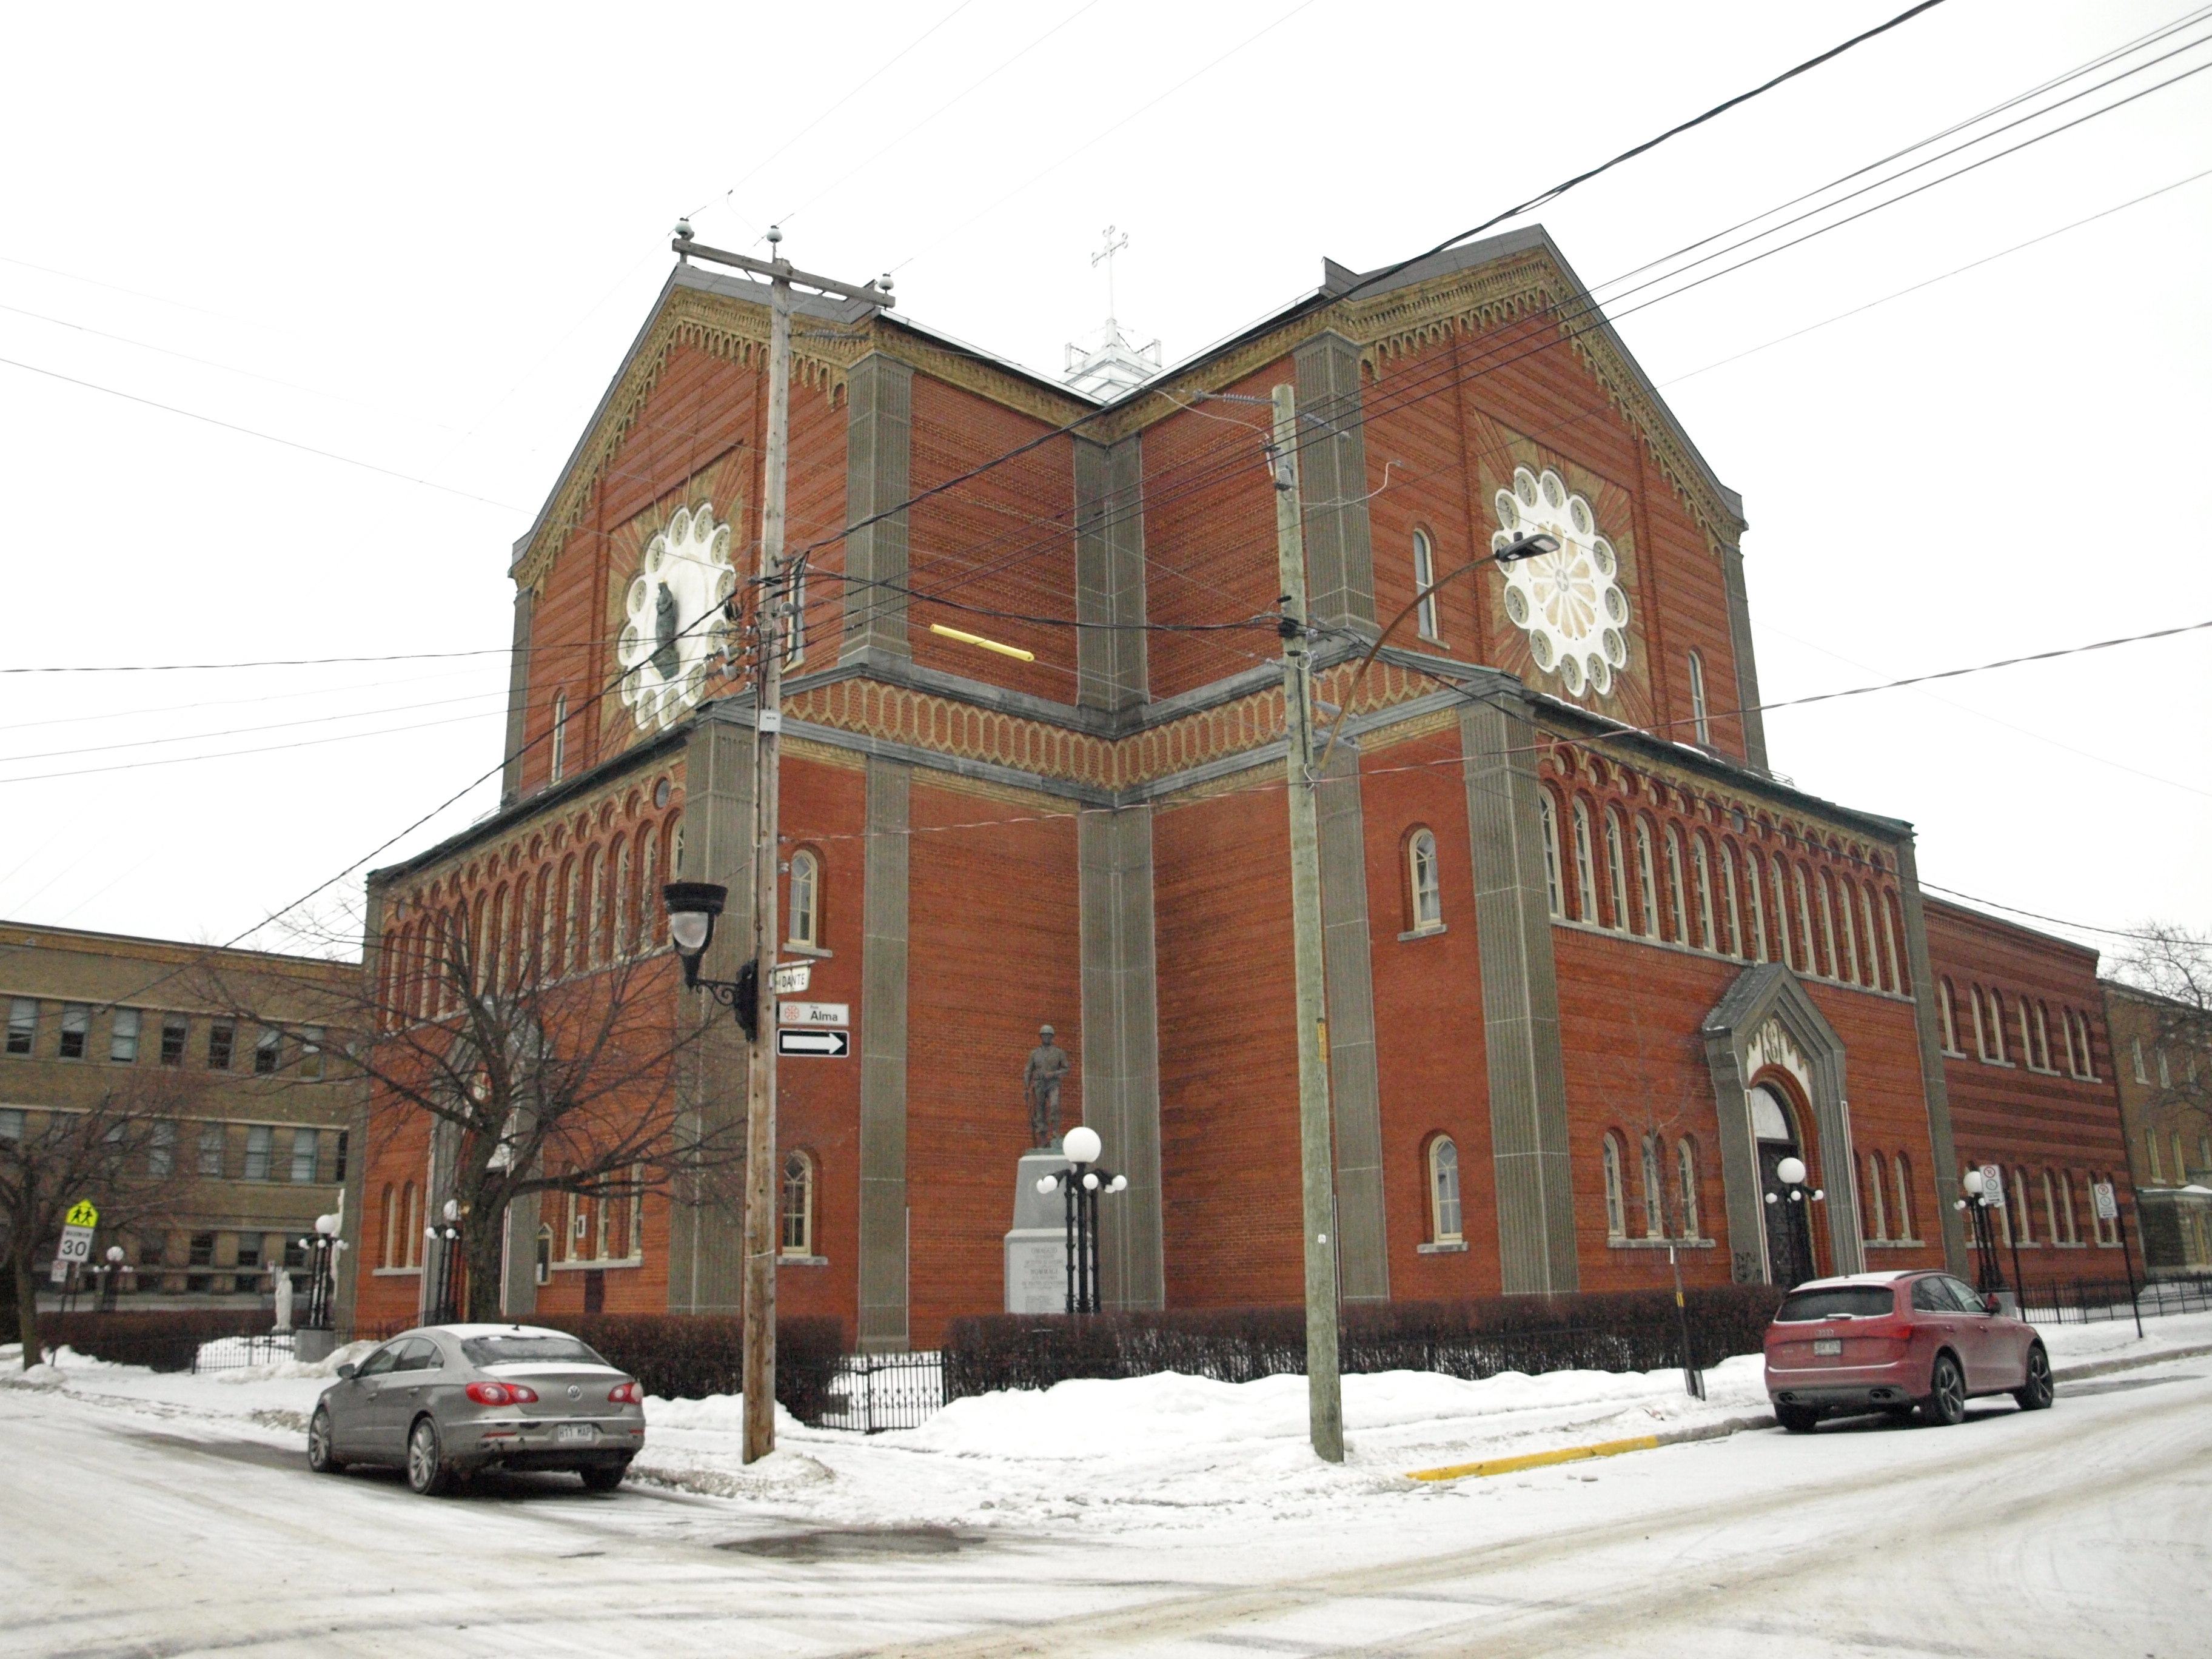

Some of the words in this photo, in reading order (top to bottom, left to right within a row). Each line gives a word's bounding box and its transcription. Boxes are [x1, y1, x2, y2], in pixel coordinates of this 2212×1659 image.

[782, 973, 805, 988] DANTE
[810, 1010, 838, 1021] Alma
[62, 1240, 86, 1256] 30
